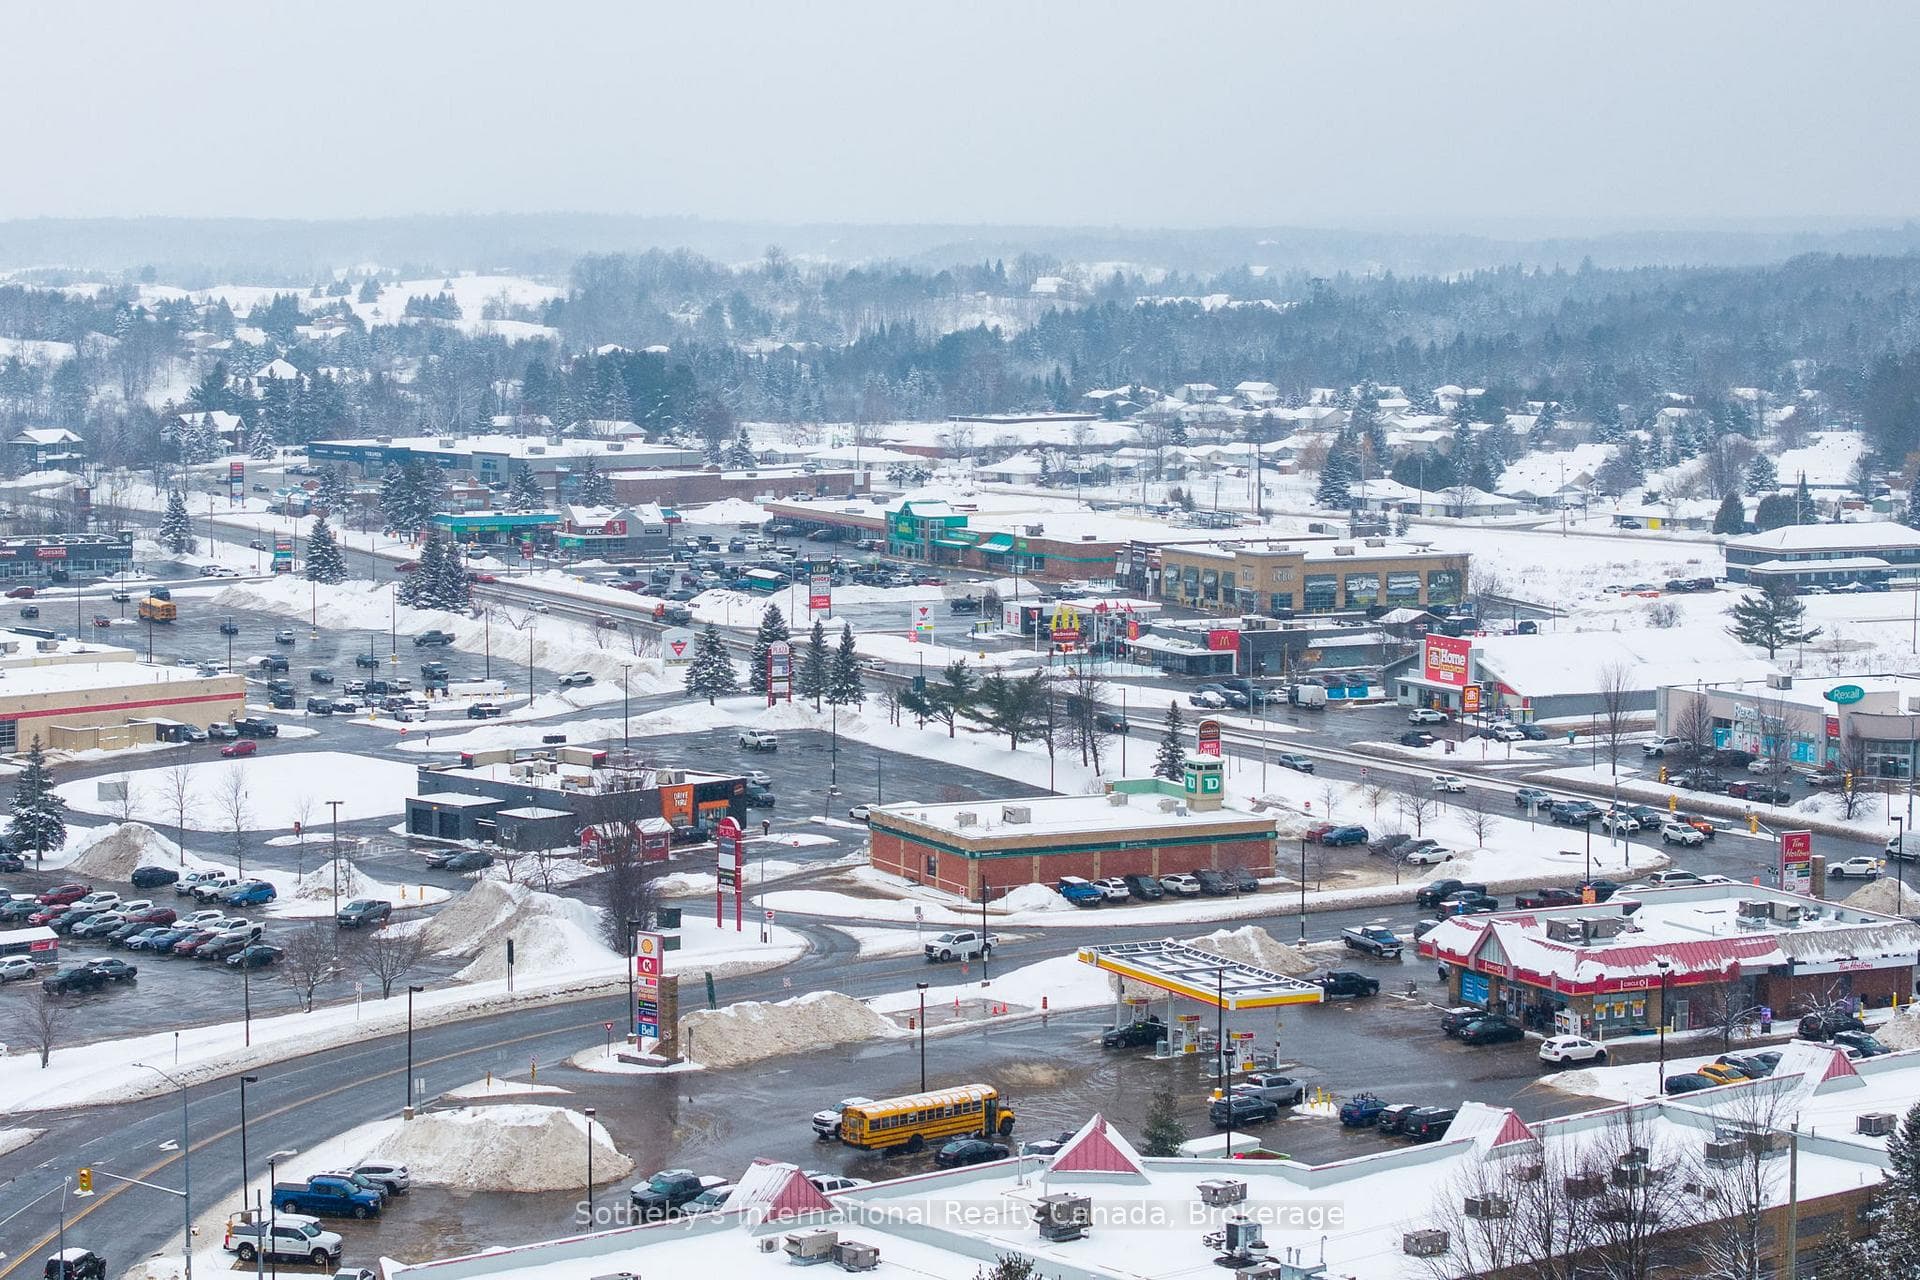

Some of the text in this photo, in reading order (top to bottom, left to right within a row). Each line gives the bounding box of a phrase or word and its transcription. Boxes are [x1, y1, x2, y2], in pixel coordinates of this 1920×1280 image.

[1441, 648, 1466, 666] Home
[1833, 689, 1860, 699] Rexall
[1734, 702, 1760, 720] Rexall
[1204, 777, 1219, 790] TD
[673, 791, 689, 799] DRIVE
[1791, 837, 1805, 848] Tim
[1785, 848, 1810, 857] Hortons
[1839, 961, 1873, 970] Tim Hortons
[641, 1024, 655, 1036] Bell
